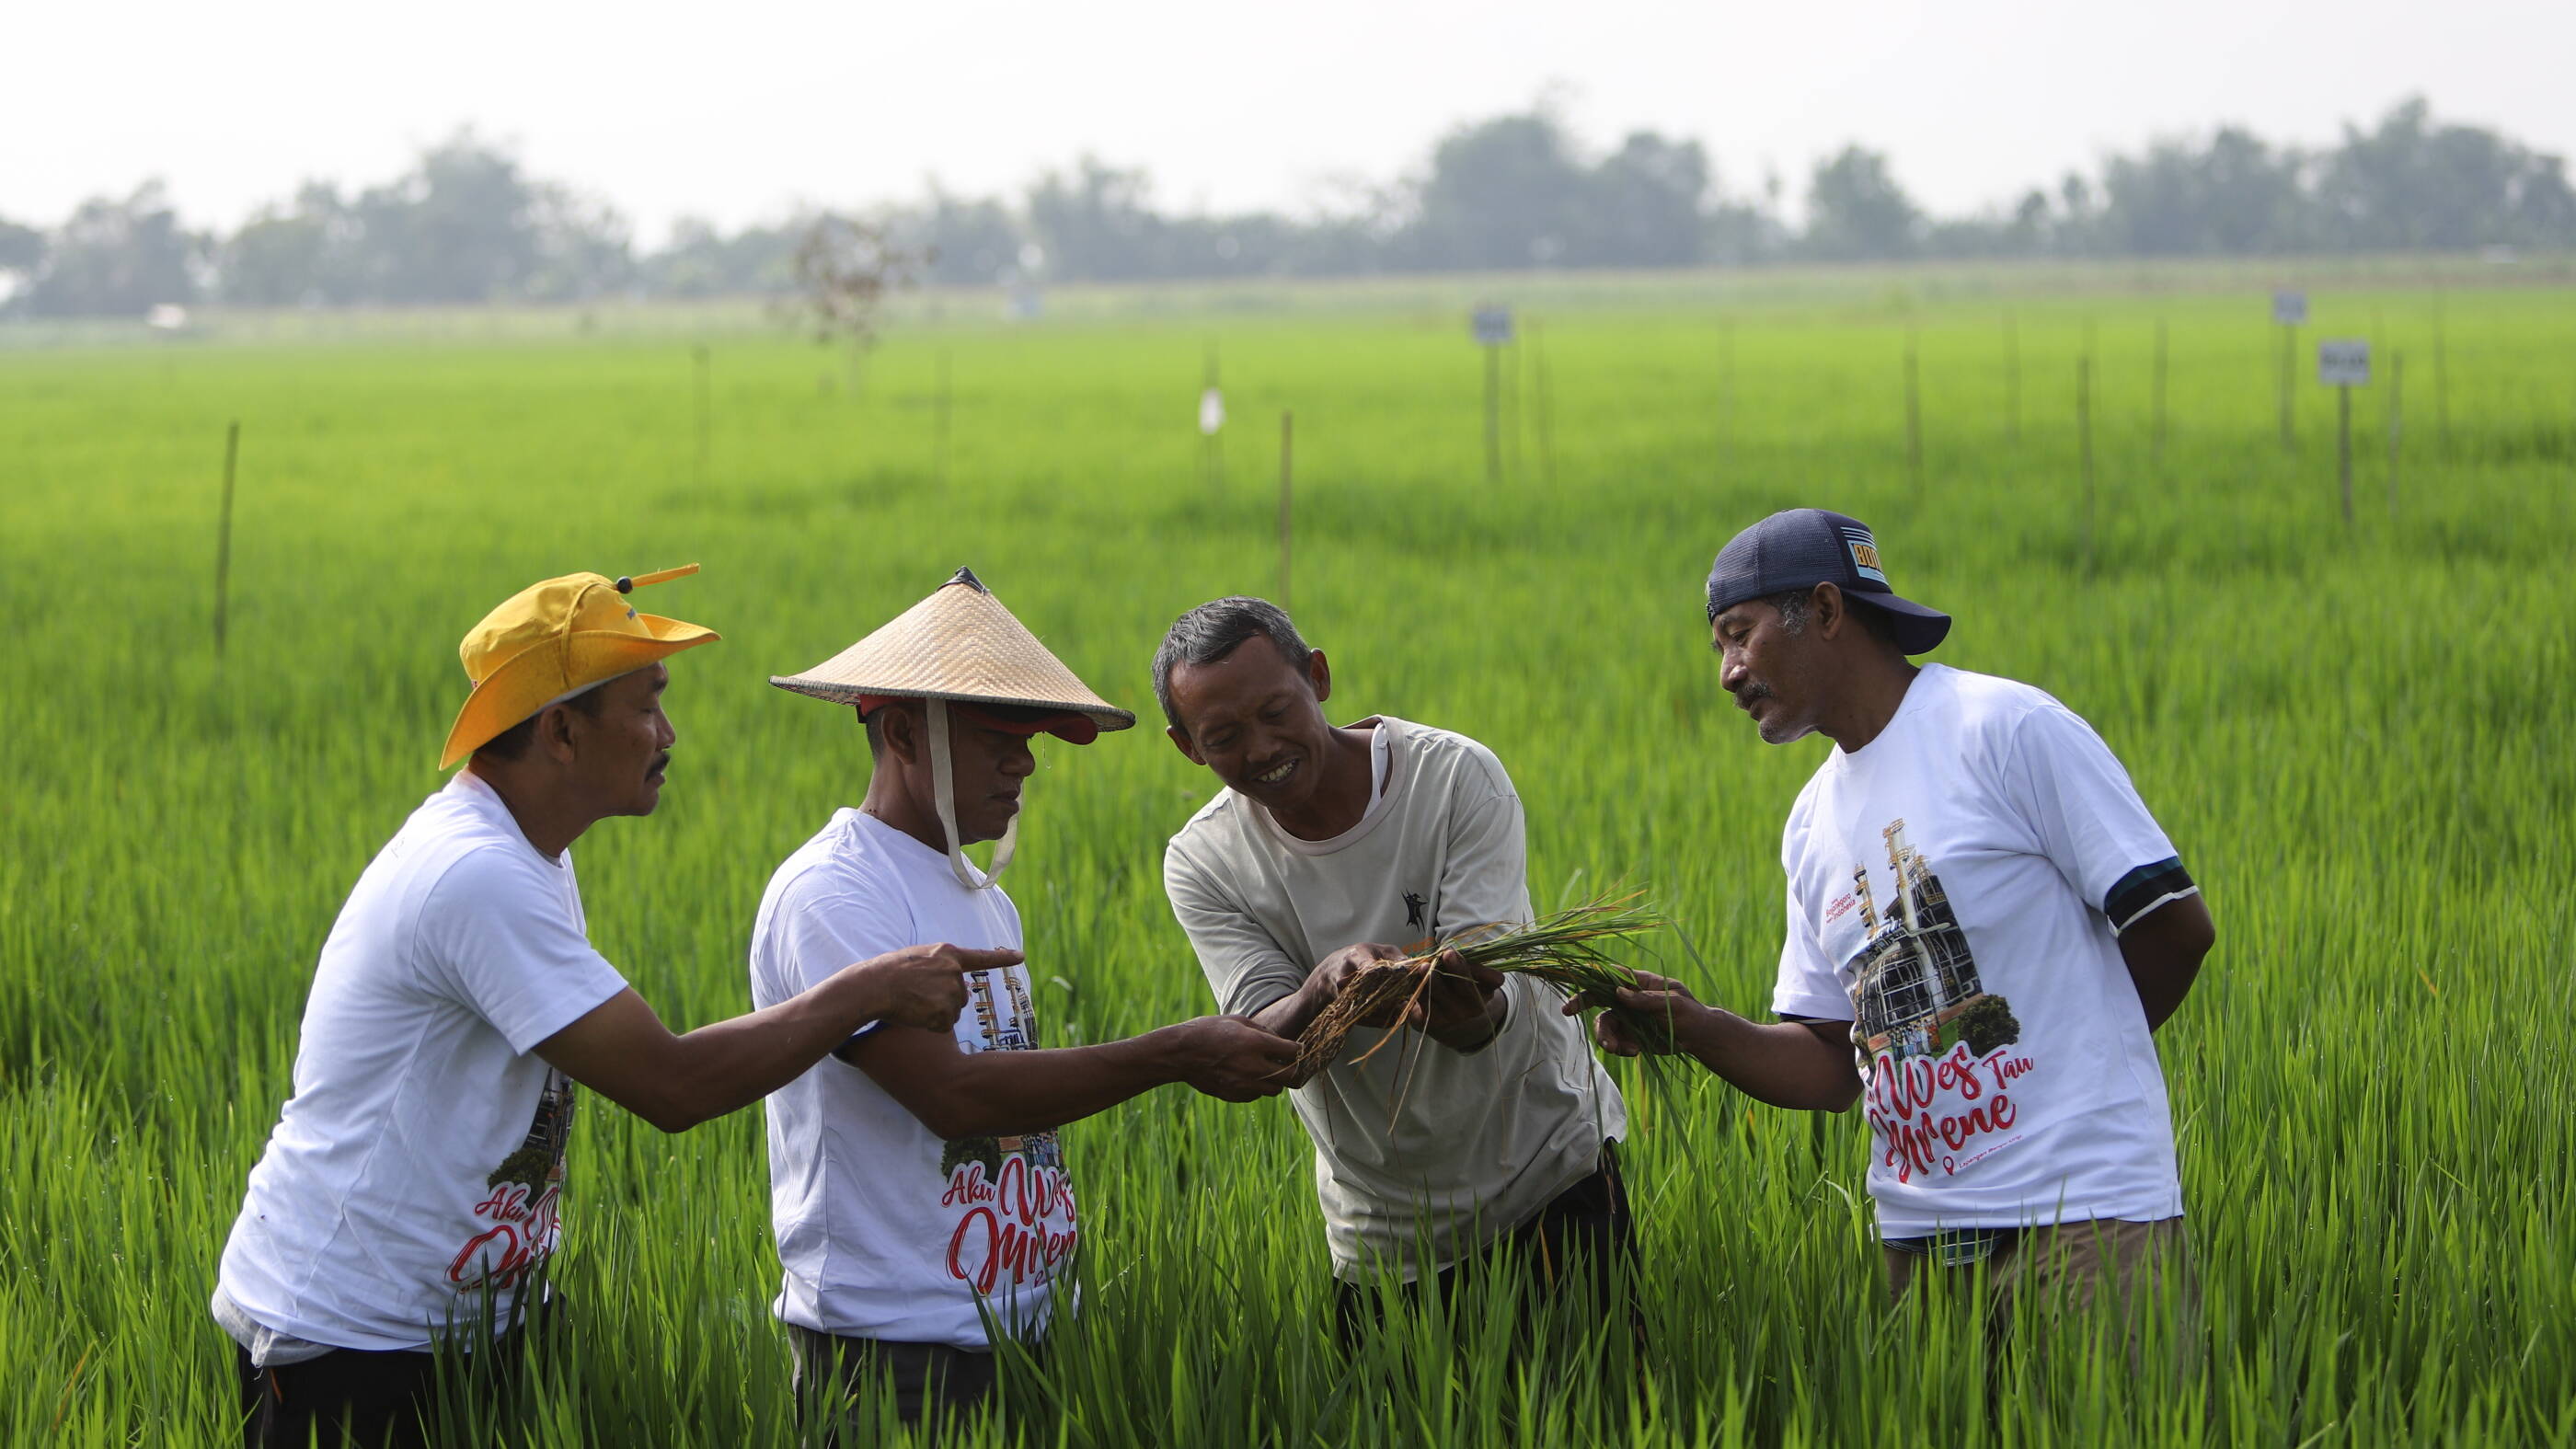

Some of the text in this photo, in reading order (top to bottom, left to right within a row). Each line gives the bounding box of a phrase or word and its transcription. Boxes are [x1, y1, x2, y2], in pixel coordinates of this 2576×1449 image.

[1875, 1045, 1982, 1121] Wes
[1982, 1050, 2033, 1089] Tau
[474, 1186, 527, 1222] Aku
[941, 1166, 995, 1206] Aku
